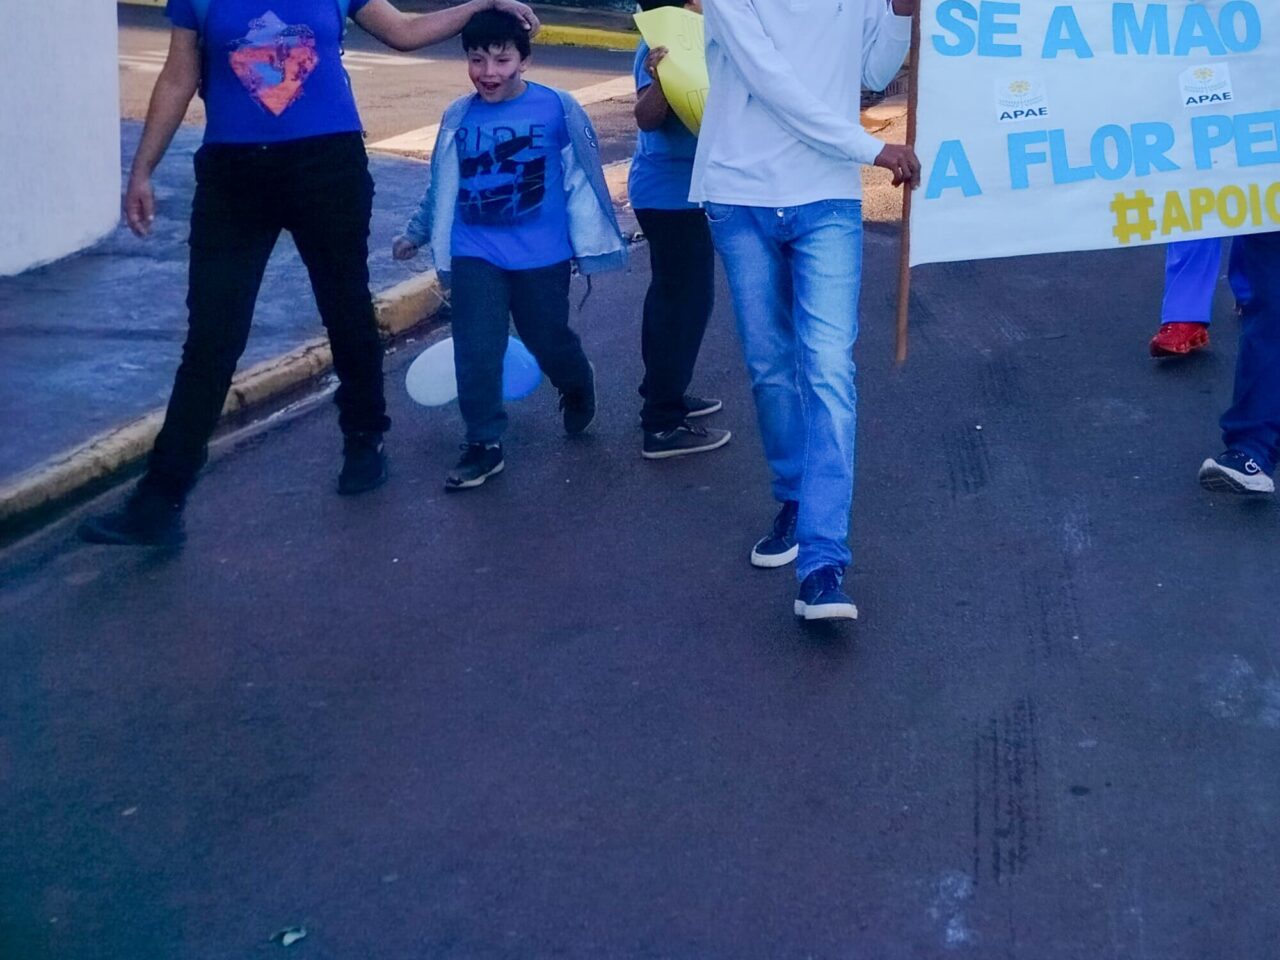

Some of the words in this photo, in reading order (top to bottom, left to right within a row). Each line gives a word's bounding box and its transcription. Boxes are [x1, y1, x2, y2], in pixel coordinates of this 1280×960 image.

[932, 0, 1023, 59] SE
[1042, 7, 1094, 60] A
[999, 107, 1048, 120] APAE
[1186, 92, 1232, 105] APAE
[926, 140, 983, 200] A
[1008, 121, 1182, 191] FLOR
